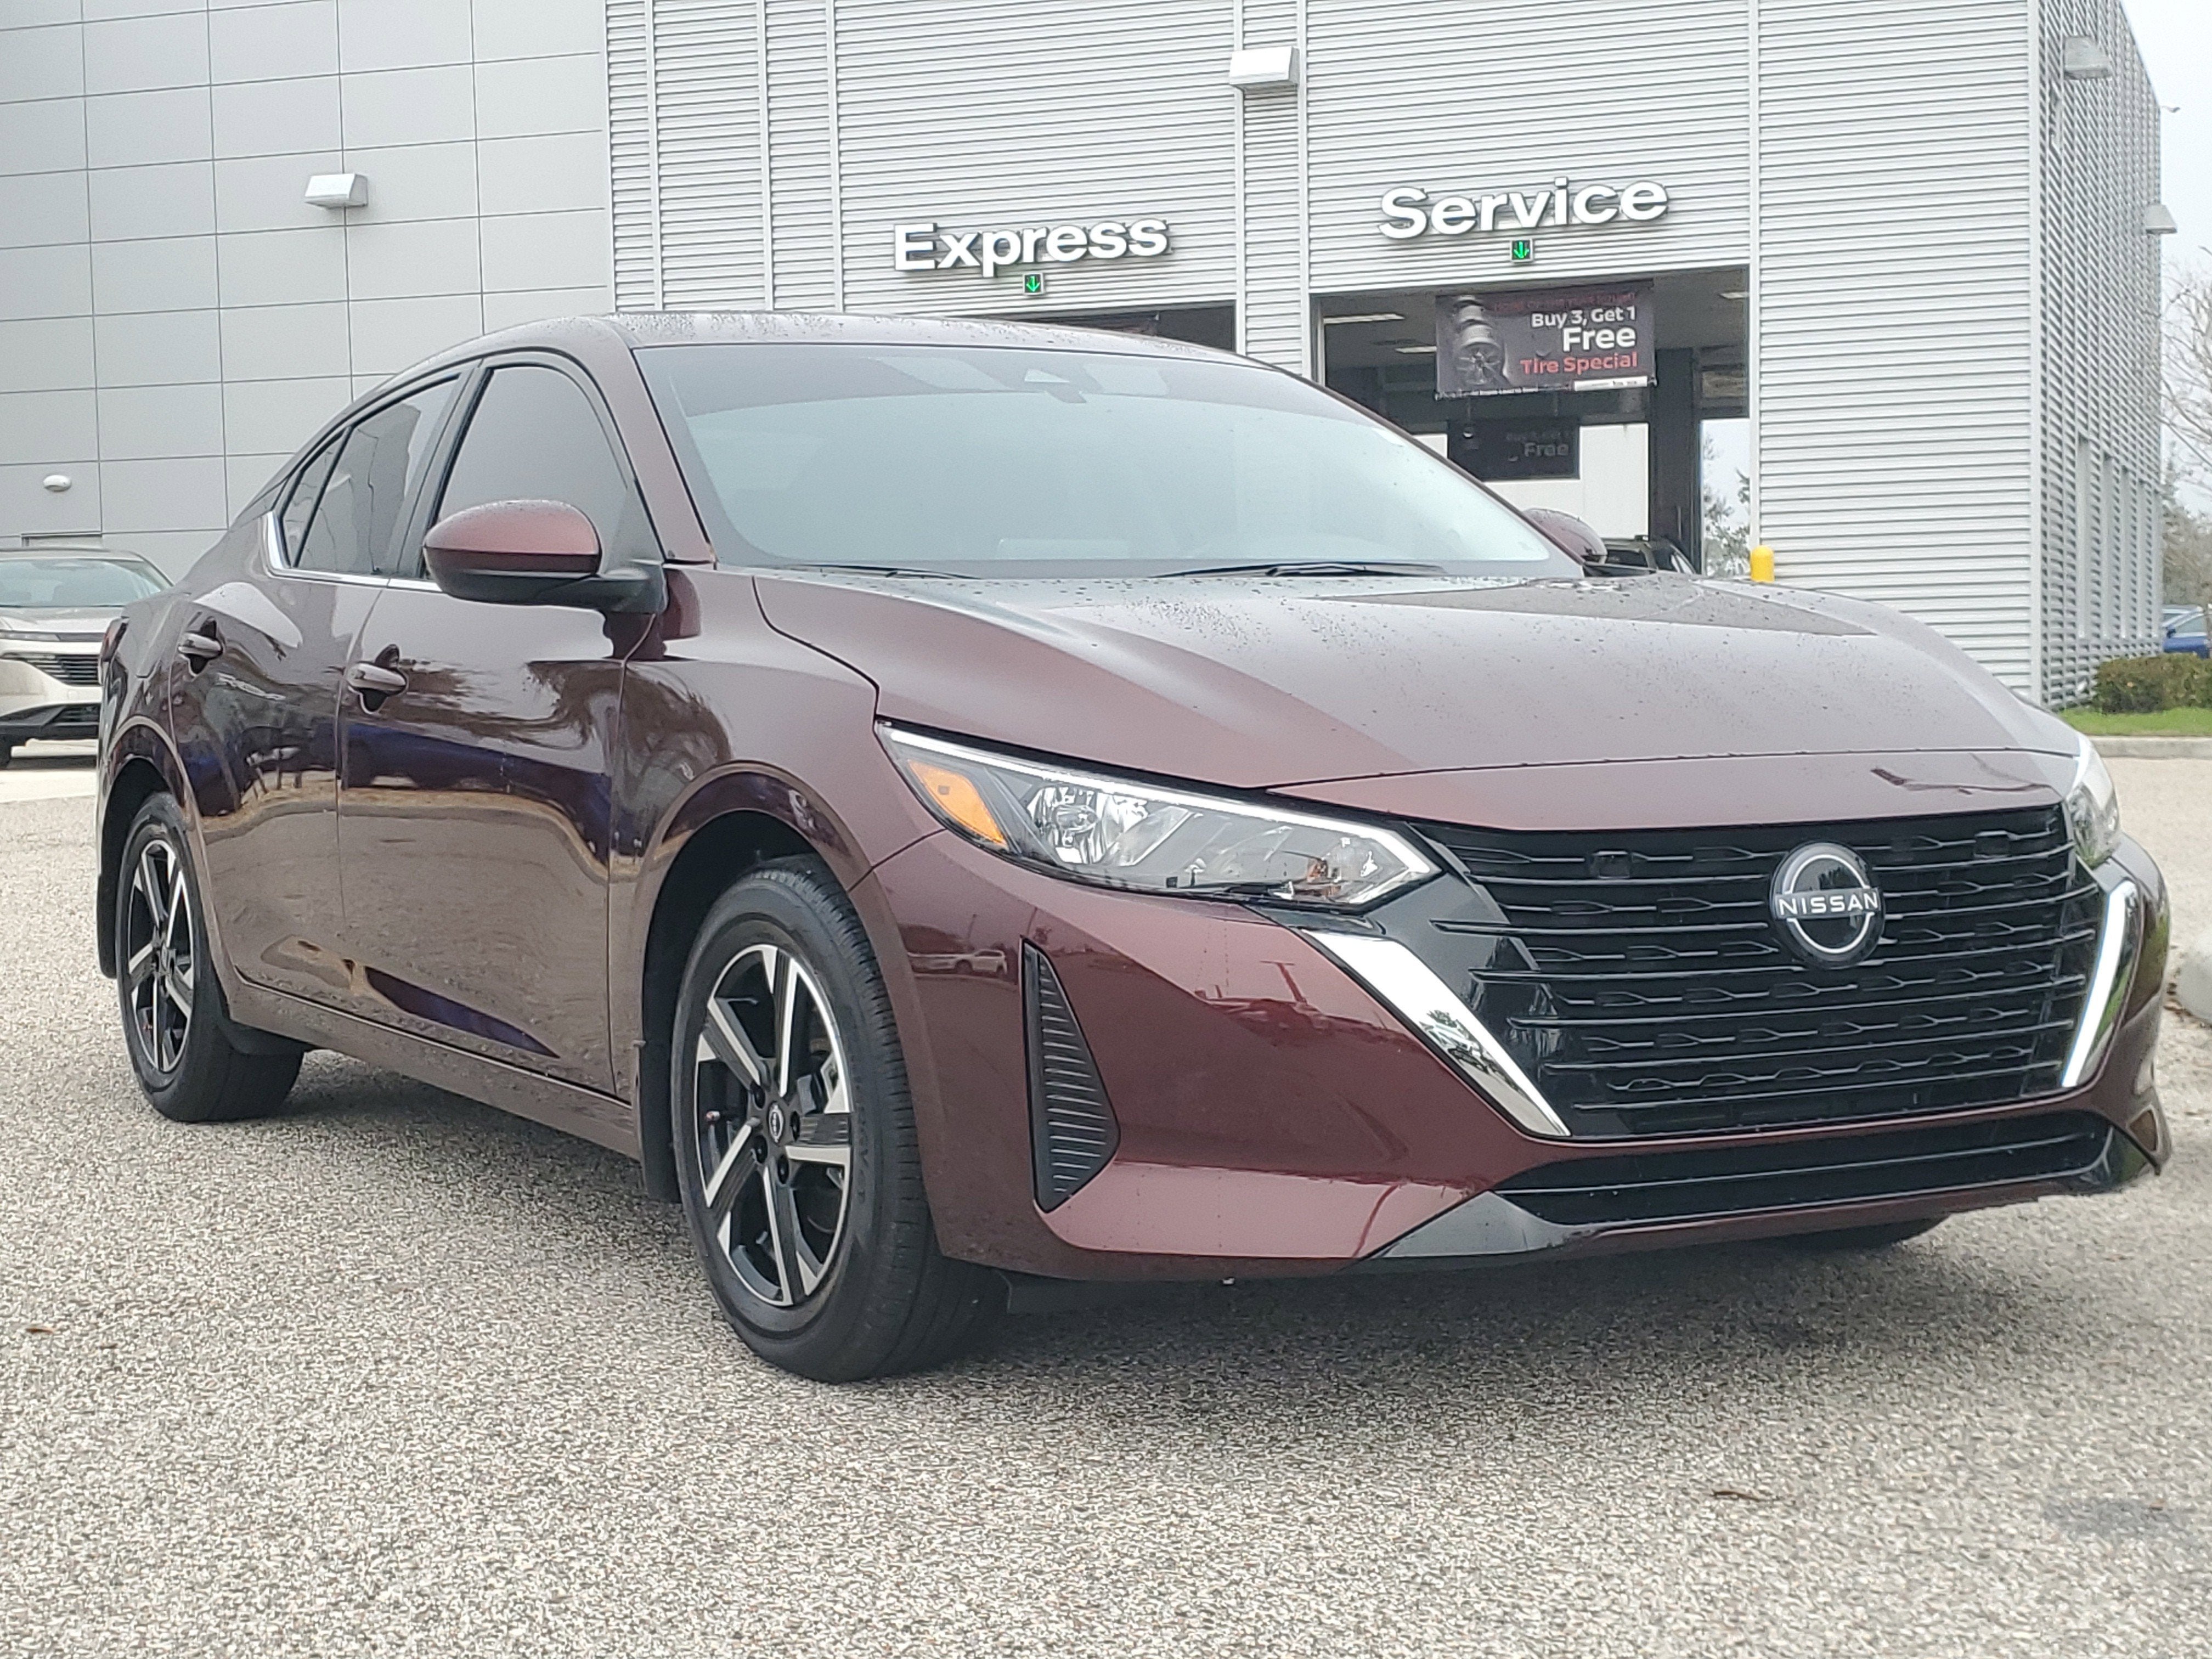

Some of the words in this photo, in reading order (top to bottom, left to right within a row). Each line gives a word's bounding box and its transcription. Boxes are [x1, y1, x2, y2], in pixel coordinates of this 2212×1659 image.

[1378, 177, 1668, 239] Service
[894, 219, 1169, 277] Express
[1531, 311, 1567, 329] Buy
[1571, 309, 1588, 326] 3,
[1591, 307, 1624, 323] Get
[1627, 306, 1636, 320] 1
[1563, 326, 1637, 352] Free
[1520, 358, 1559, 375] Tire
[1564, 352, 1638, 375] Special
[1523, 442, 1569, 458] Free
[1778, 891, 1878, 916] NISSAN
